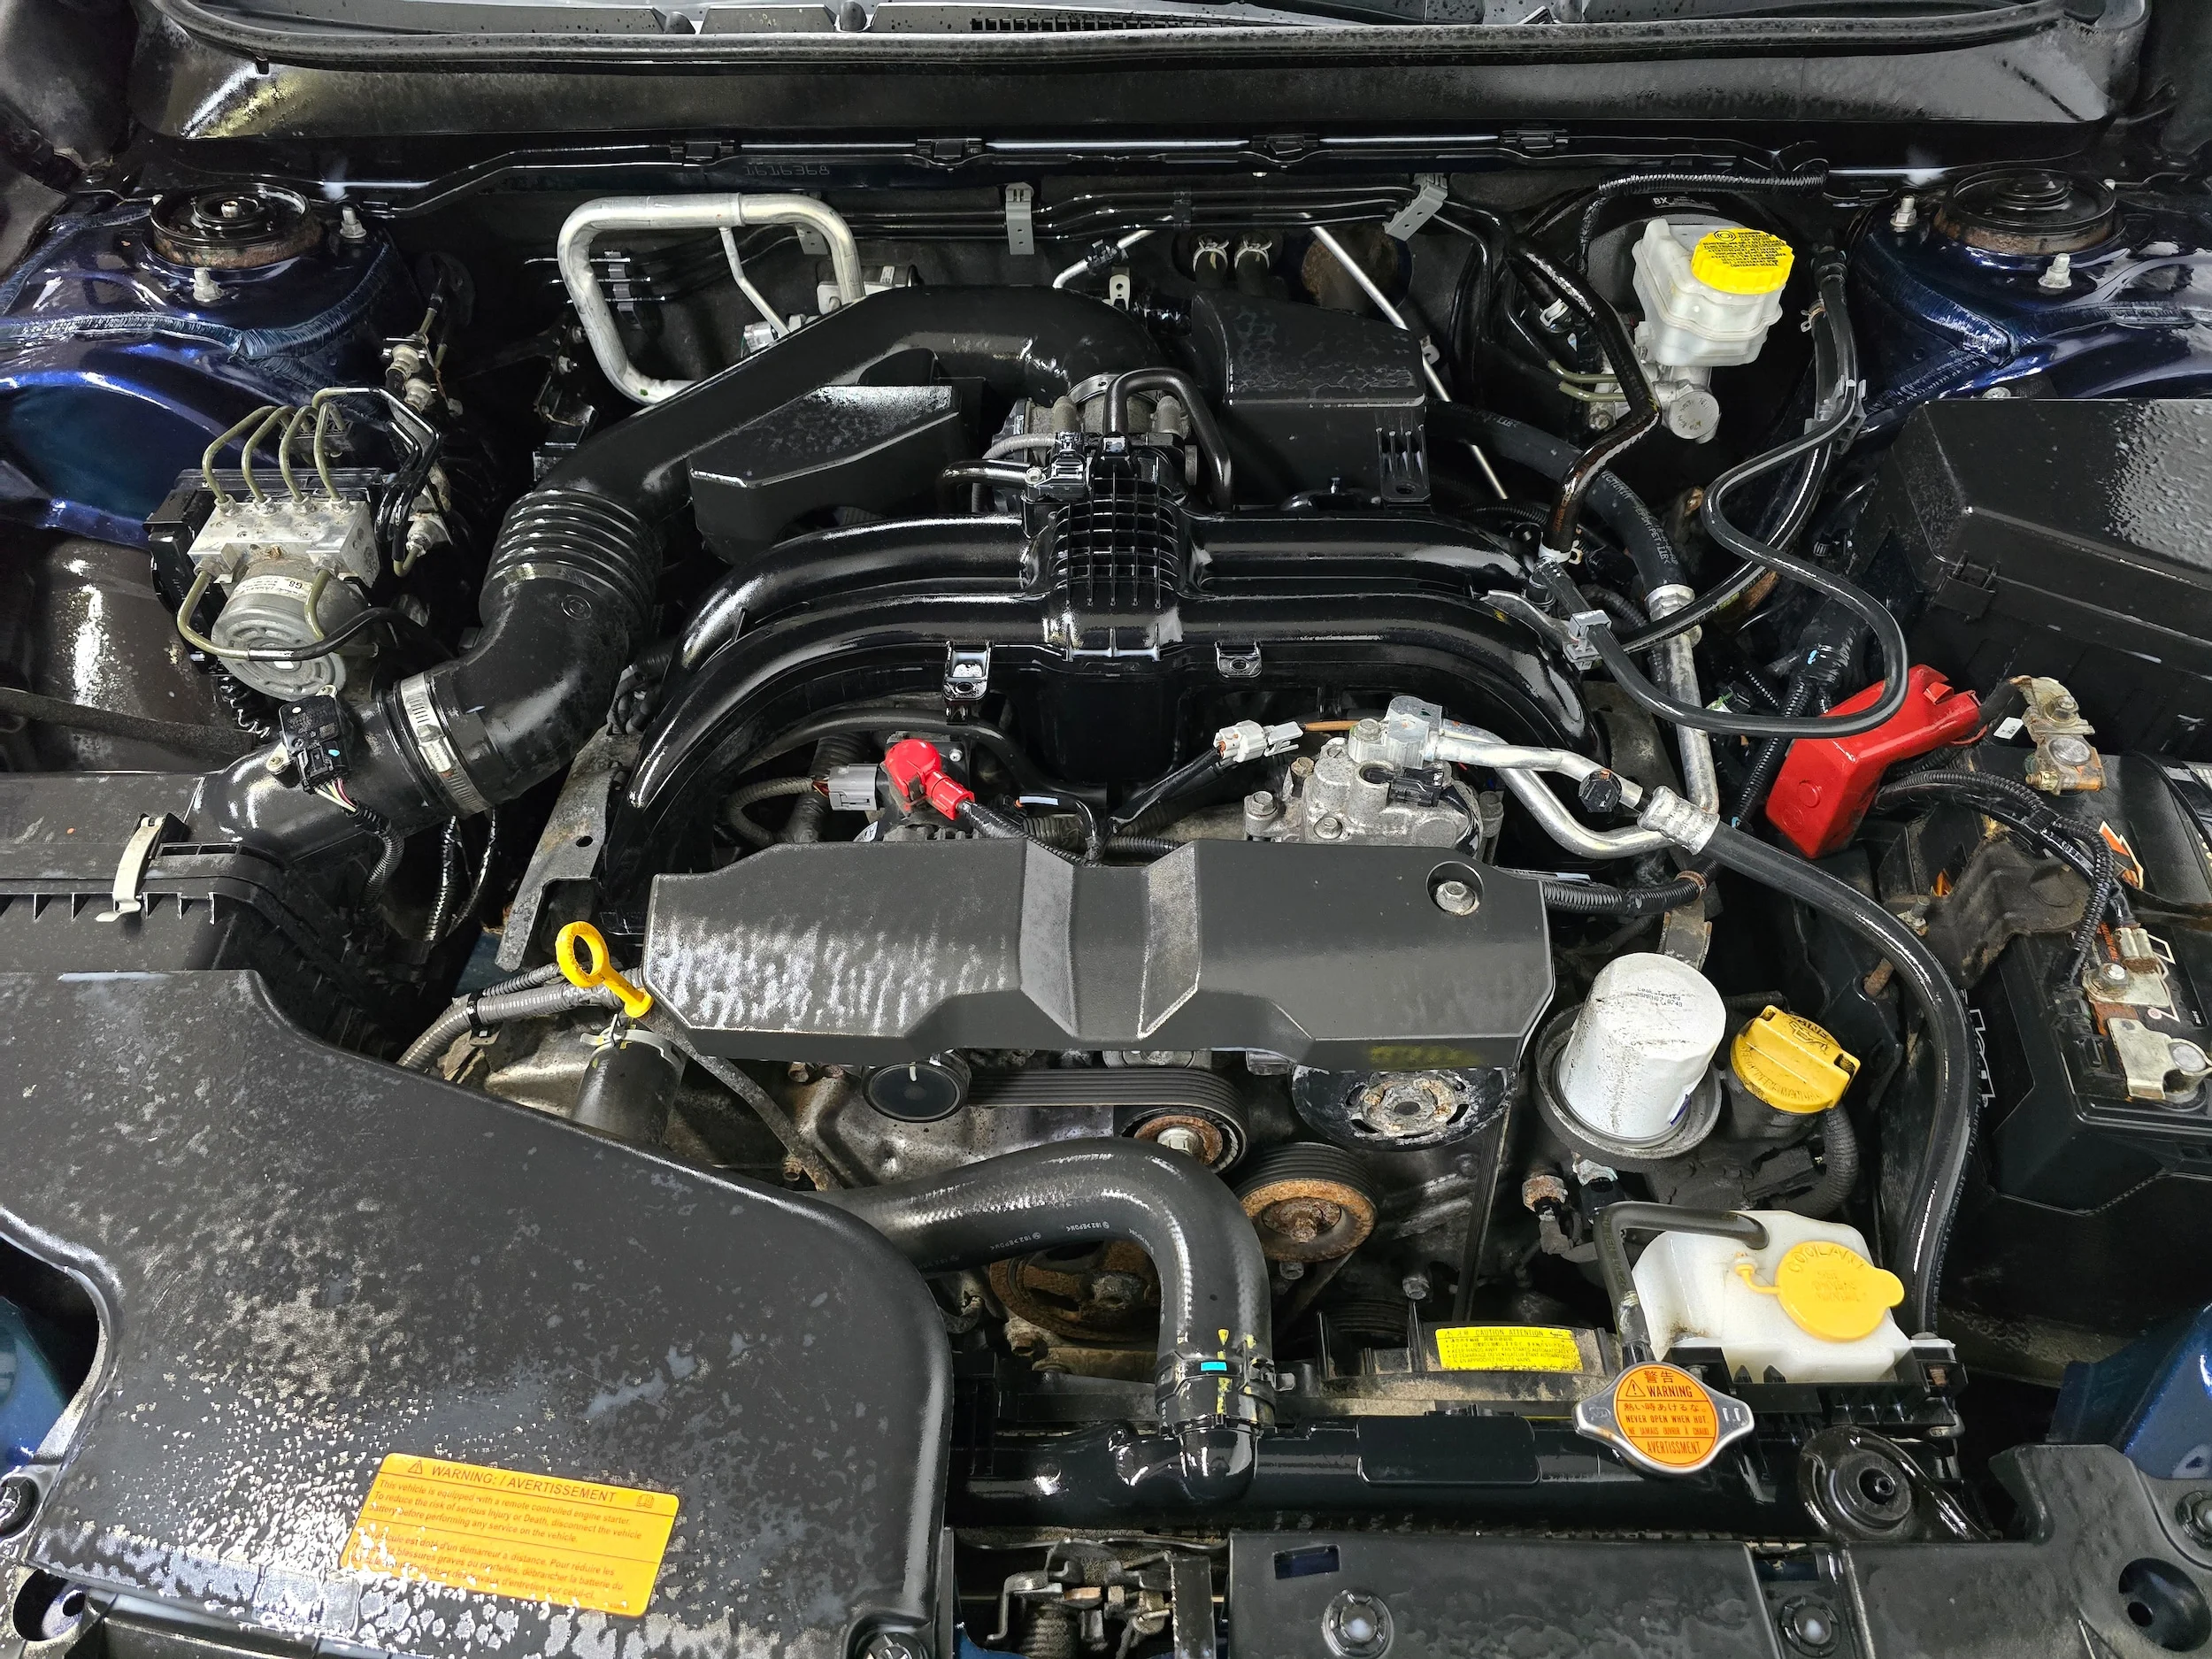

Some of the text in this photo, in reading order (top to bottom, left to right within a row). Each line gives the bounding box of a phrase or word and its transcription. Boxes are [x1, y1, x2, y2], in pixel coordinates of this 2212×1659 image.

[742, 165, 831, 176] 1616368
[1653, 196, 1669, 205] BX
[1787, 1244, 1864, 1272] COOLANT
[1509, 1328, 1544, 1337] ATTENTION
[1644, 1370, 1674, 1383] 警告
[1647, 1385, 1694, 1397] WARNING
[1671, 1415, 1691, 1424] WHEN
[1628, 1426, 1635, 1435] NE
[1640, 1426, 1659, 1435] JAMAIS
[1647, 1440, 1701, 1455] AVERTISSMENT
[431, 1465, 497, 1484] WARNING:
[507, 1477, 616, 1502] AVERTISSEMENT
[380, 1479, 396, 1489] This
[397, 1482, 426, 1494] vehicle
[436, 1488, 474, 1502] equipped
[501, 1498, 530, 1509] remote
[531, 1502, 572, 1516] controlled
[572, 1509, 603, 1522] engine
[603, 1513, 632, 1525] starter.
[385, 1494, 412, 1504] reduce
[428, 1500, 445, 1509] risk
[456, 1504, 486, 1515] serious
[551, 1518, 596, 1532] disconnect
[598, 1525, 611, 1534] the
[613, 1528, 642, 1539] vehicle
[425, 1511, 471, 1526] performing
[472, 1520, 486, 1529] any
[488, 1521, 518, 1532] service
[532, 1528, 545, 1537] the
[547, 1530, 579, 1541] vehicle.
[440, 1541, 458, 1551] d'un
[459, 1544, 501, 1557] démarreur
[549, 1558, 570, 1568] Pour
[571, 1562, 601, 1573] réduire
[603, 1566, 615, 1575] les
[396, 1548, 436, 1561] blessures
[437, 1555, 464, 1567] graves
[522, 1567, 567, 1581] débrancher
[579, 1576, 611, 1587] batterie
[612, 1581, 624, 1590] du
[502, 1577, 547, 1591] d'entretien
